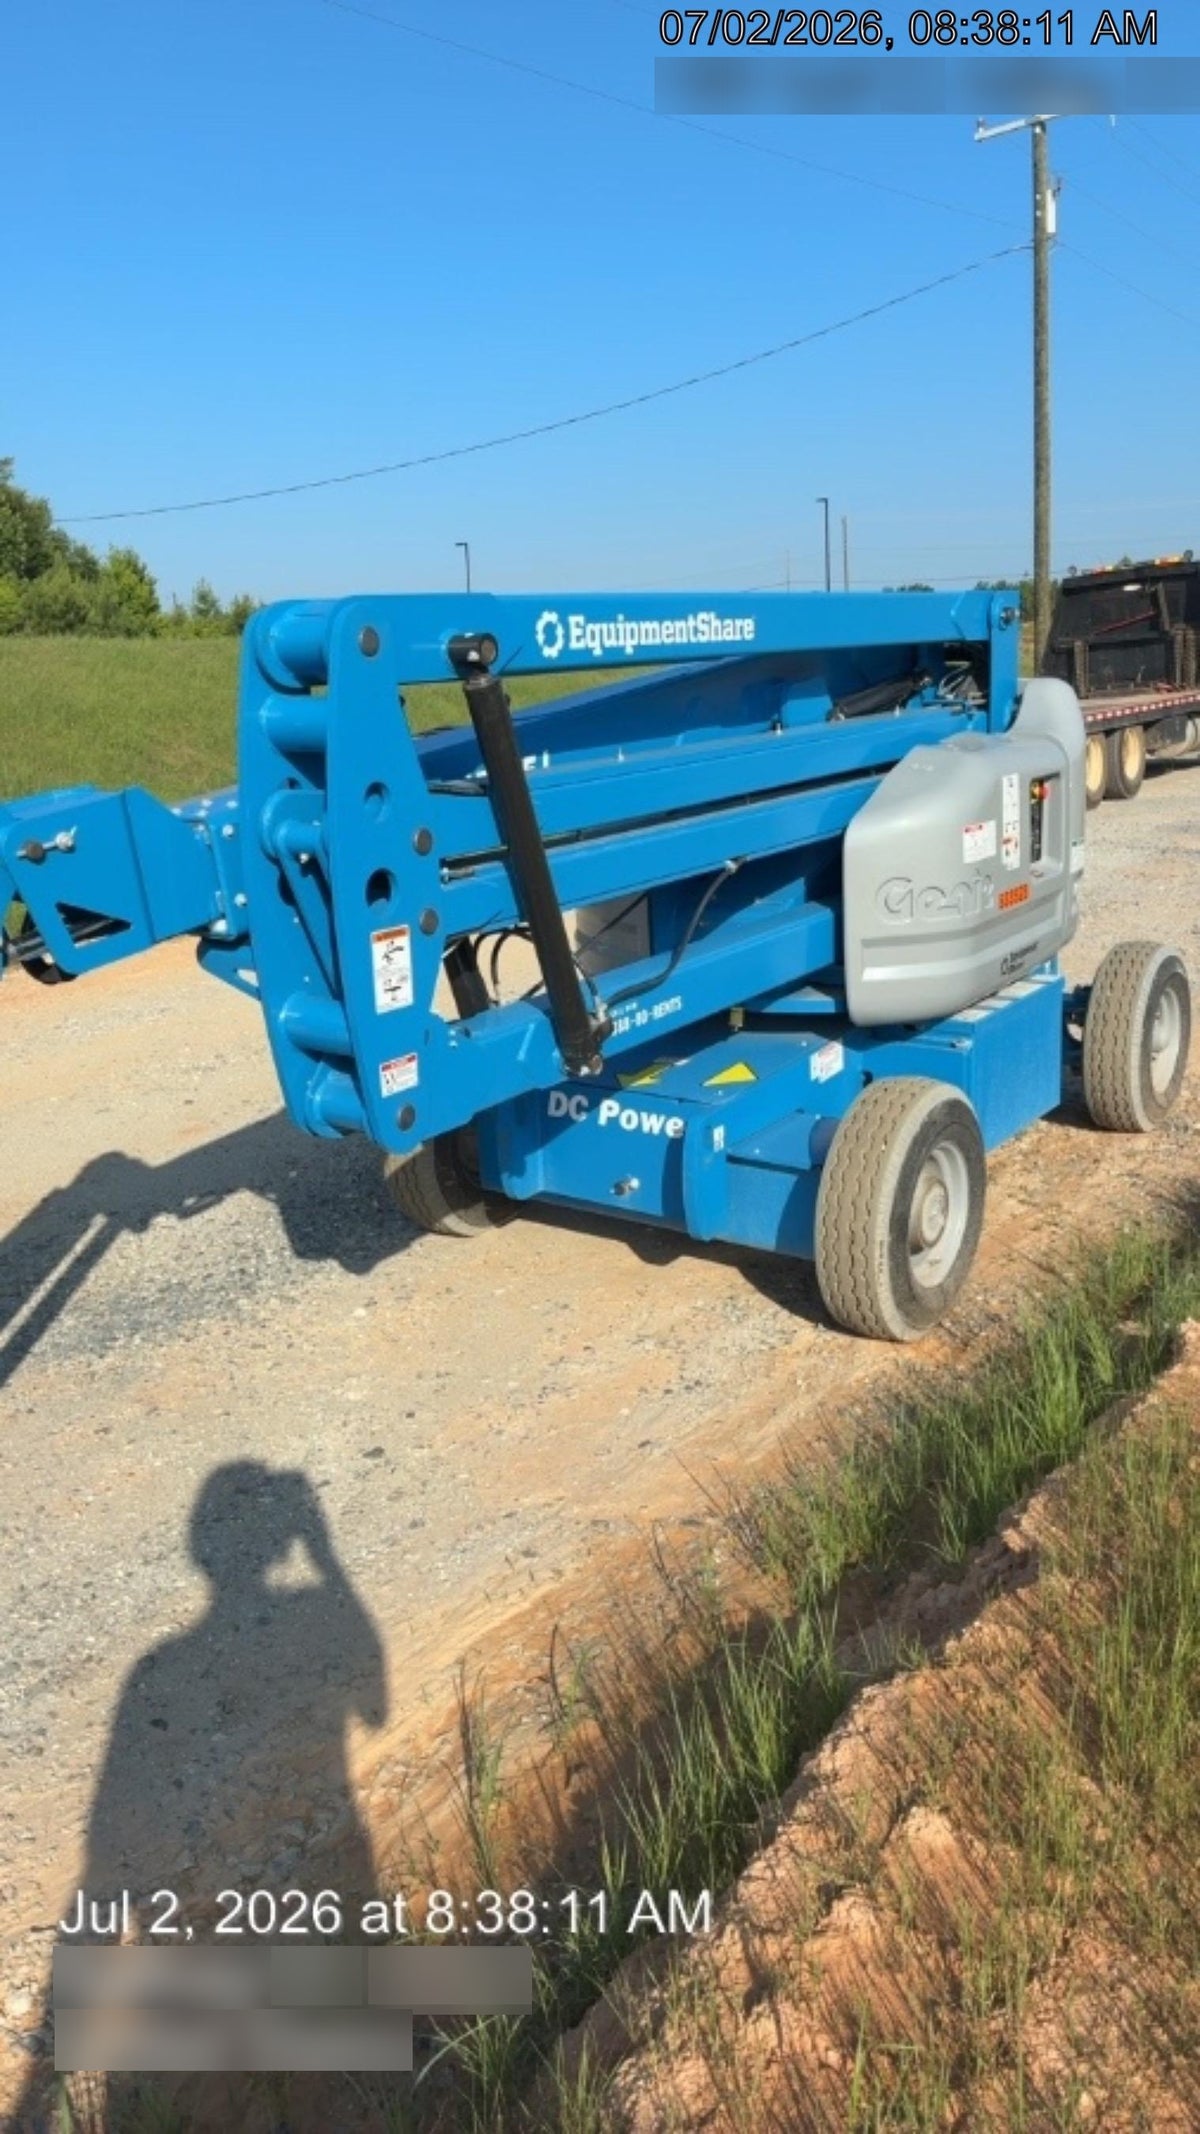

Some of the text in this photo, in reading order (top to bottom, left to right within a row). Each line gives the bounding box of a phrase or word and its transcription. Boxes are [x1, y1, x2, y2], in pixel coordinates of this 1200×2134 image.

[568, 612, 755, 656] EquipmentShare
[547, 1090, 589, 1122] DC
[598, 1098, 684, 1139] Powe
